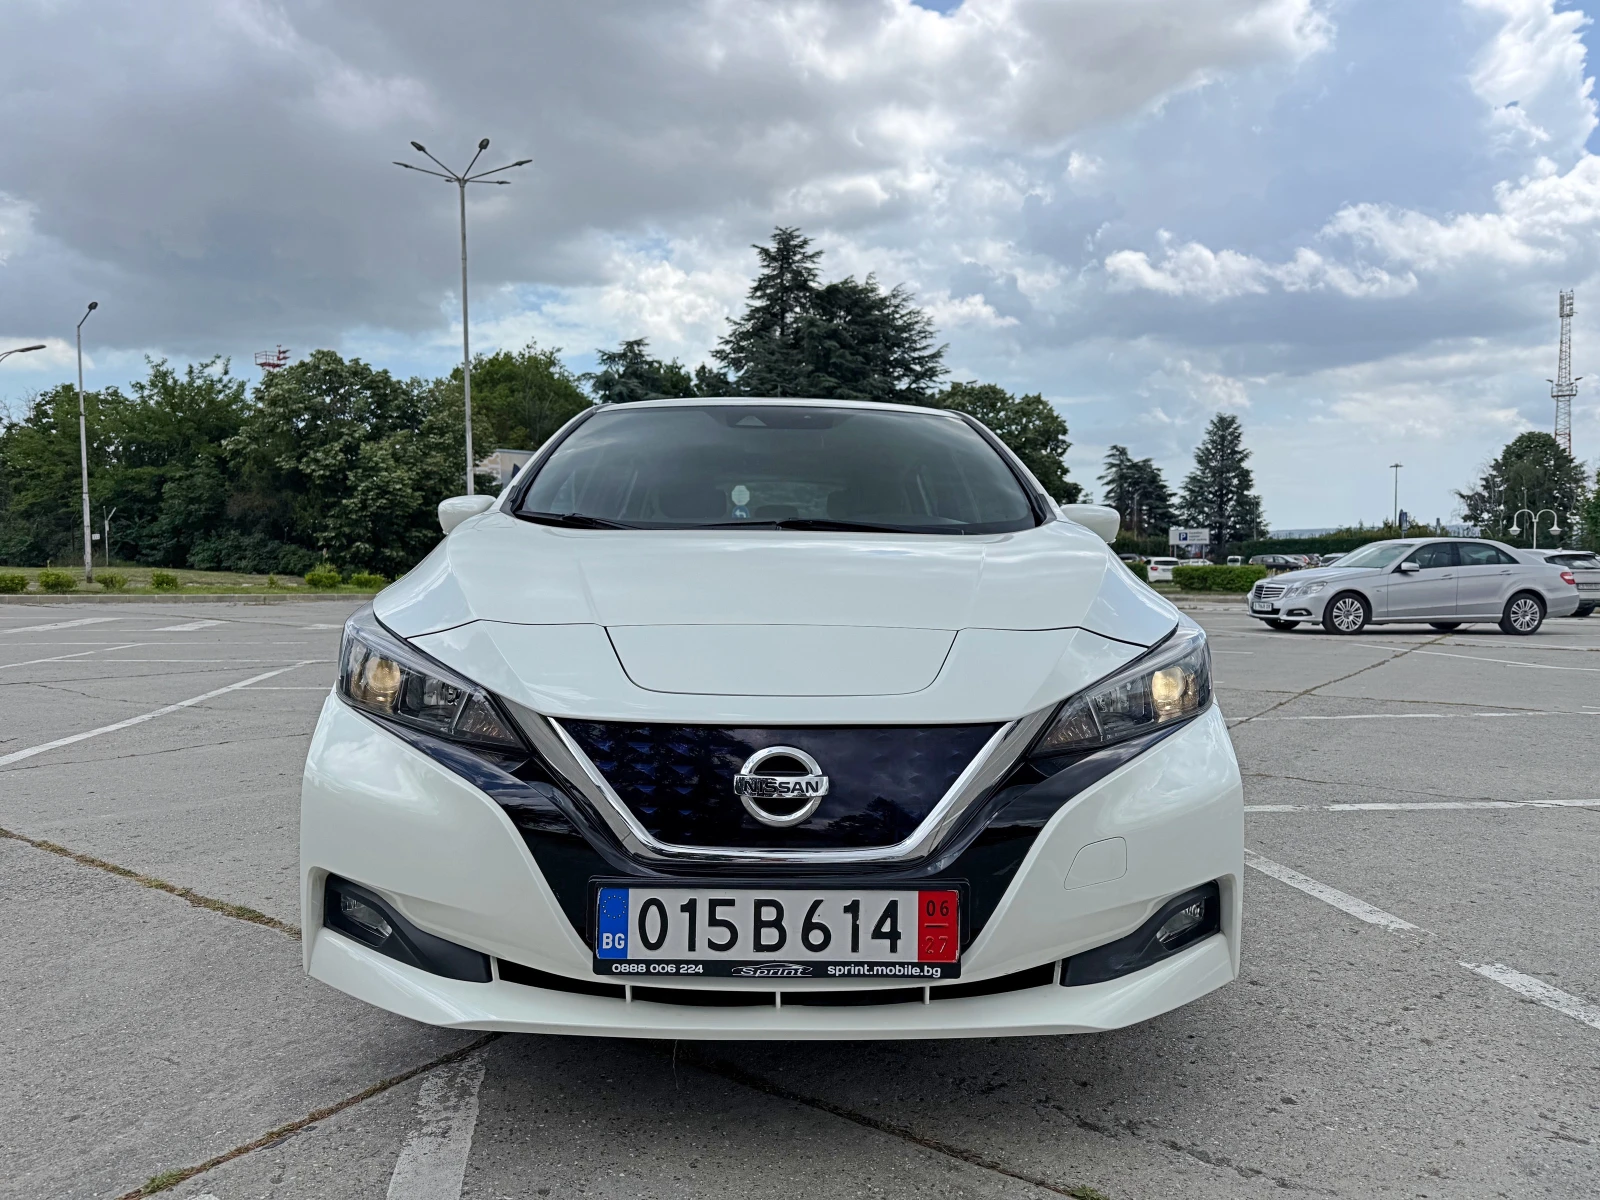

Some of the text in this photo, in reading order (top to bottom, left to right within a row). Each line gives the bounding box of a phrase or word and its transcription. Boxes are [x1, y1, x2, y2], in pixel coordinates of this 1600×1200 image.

[743, 780, 819, 794] NISSAN
[926, 899, 950, 917] 06
[602, 932, 625, 949] BG
[925, 935, 949, 954] 27
[612, 963, 704, 974] 0888 006 224
[741, 967, 804, 977] Sprint
[827, 964, 942, 978] sprint.mobile.bg
